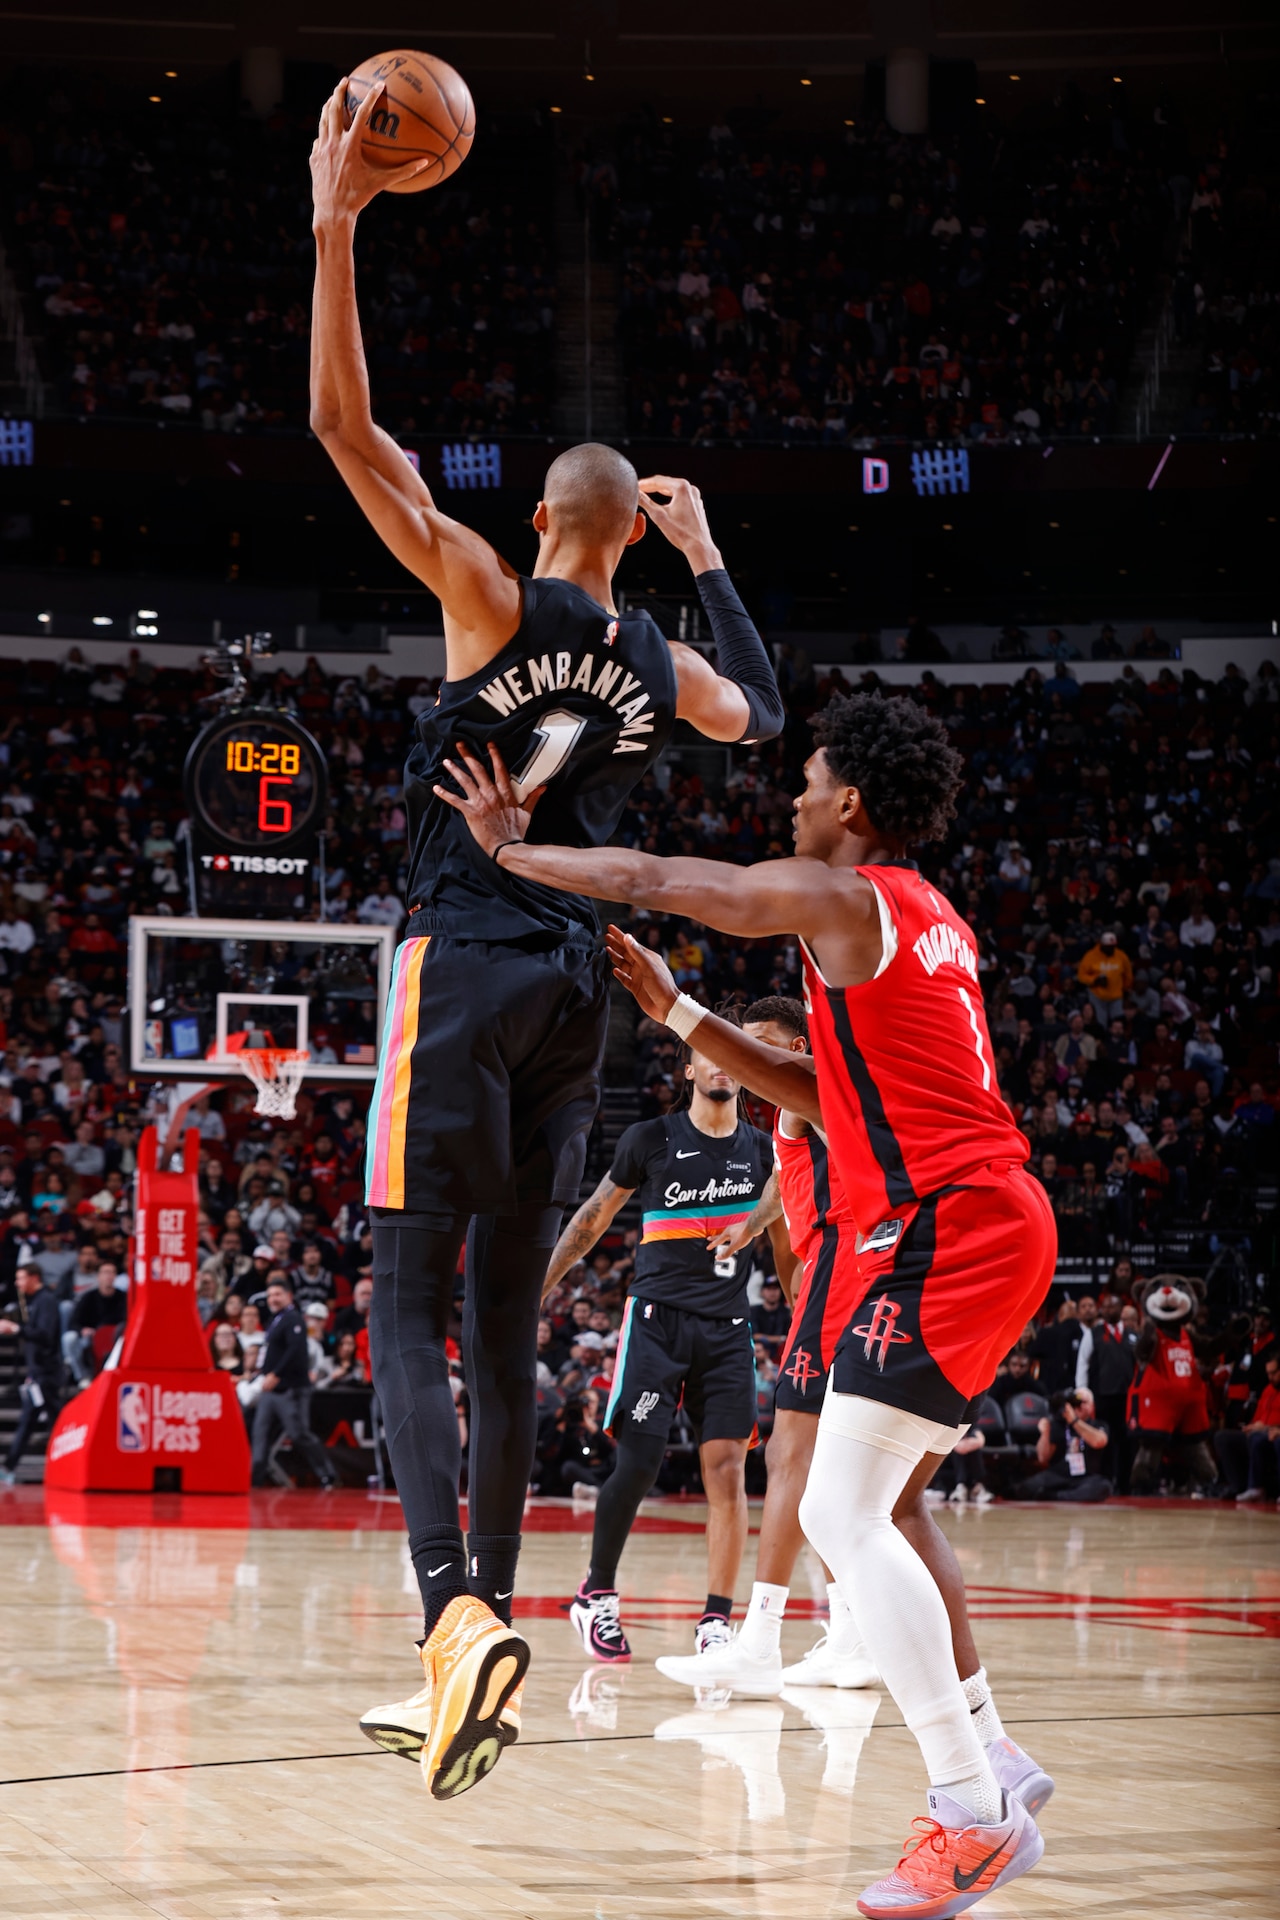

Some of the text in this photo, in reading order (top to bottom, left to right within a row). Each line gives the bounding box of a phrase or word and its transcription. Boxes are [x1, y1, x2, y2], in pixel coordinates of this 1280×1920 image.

[478, 651, 655, 754] WEMBANYAMA
[226, 741, 300, 775] 10:28
[258, 776, 293, 833] 6
[229, 855, 309, 875] TISSOT
[957, 987, 990, 1091] 1
[664, 1178, 755, 1208] San Antonio
[158, 1208, 186, 1232] GET
[152, 1384, 222, 1424] League
[152, 1418, 201, 1452] Pass
